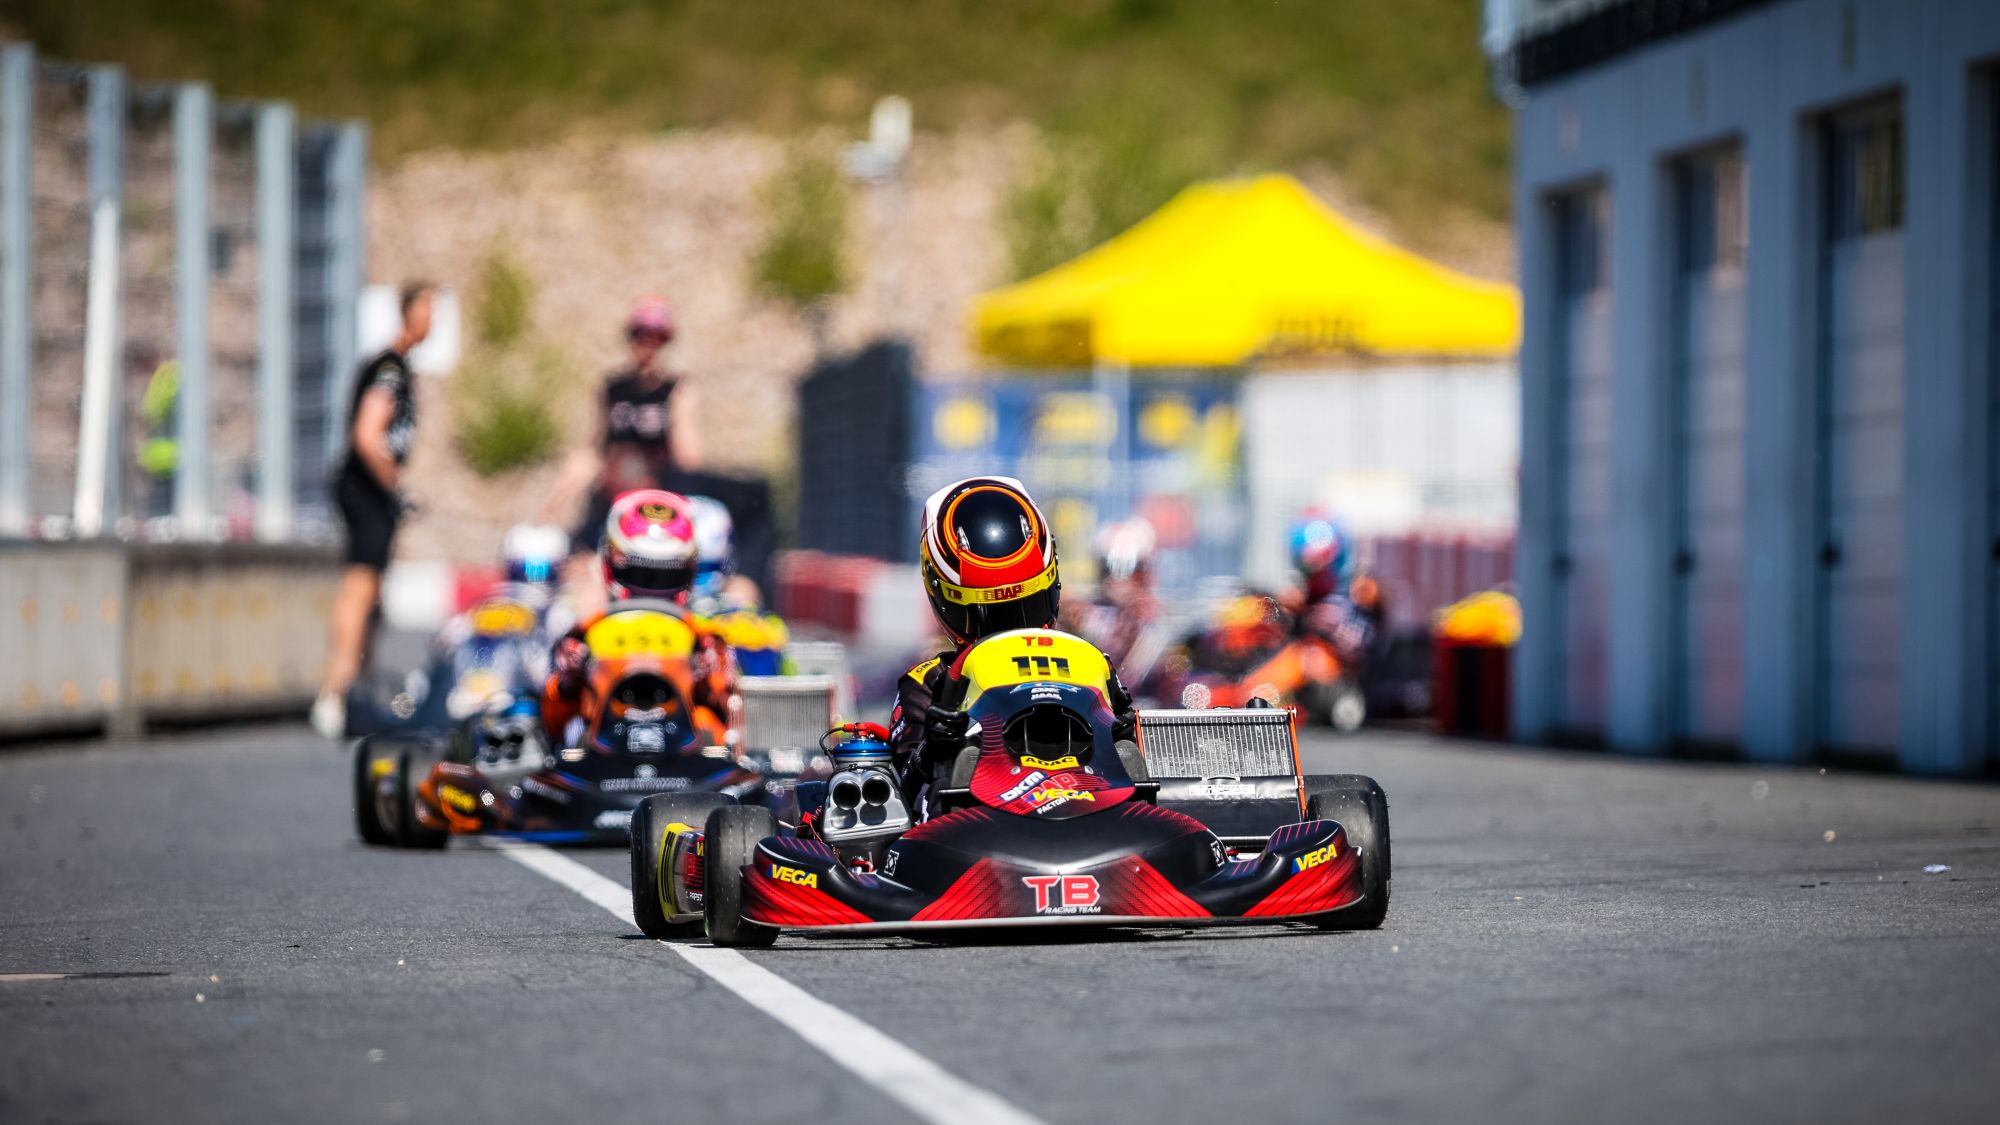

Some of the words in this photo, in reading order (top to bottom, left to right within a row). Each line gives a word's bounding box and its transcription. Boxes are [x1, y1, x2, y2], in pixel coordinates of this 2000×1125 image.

[1021, 636, 1054, 647] TB
[1011, 656, 1071, 678] 111
[1025, 757, 1075, 766] ADAC
[1000, 771, 1046, 802] DKM
[1031, 788, 1095, 802] VEGA
[1294, 843, 1338, 872] VEGA
[770, 864, 818, 889] VEGA
[1022, 875, 1100, 913] TB
[1044, 906, 1077, 914] RACING
[1078, 906, 1101, 914] TEAM
